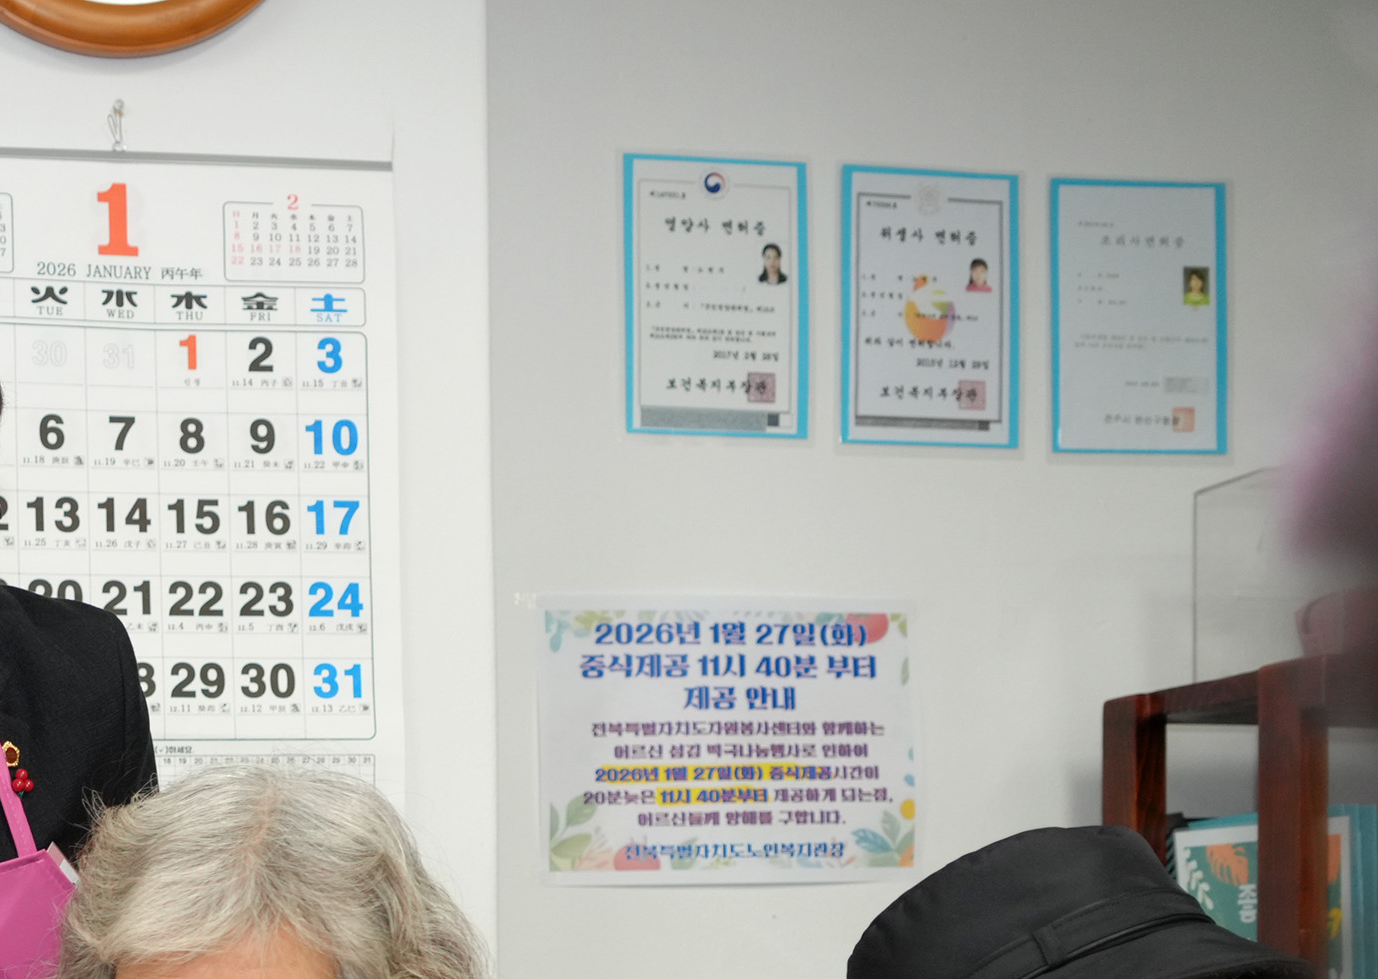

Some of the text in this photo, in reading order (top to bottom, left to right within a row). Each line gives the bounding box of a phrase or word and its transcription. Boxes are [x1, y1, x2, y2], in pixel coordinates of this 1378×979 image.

[287, 194, 299, 210] 2
[97, 182, 139, 257] 1
[37, 262, 76, 277] 2026
[86, 265, 151, 280] JANUARY
[31, 286, 68, 305] 火
[101, 288, 138, 307] 水
[170, 291, 208, 310] 木
[241, 291, 279, 311] 金
[311, 293, 348, 312] 土
[36, 306, 63, 316] TUE
[106, 308, 134, 320] WED
[176, 310, 204, 321] THU
[250, 312, 271, 322] FRI
[317, 312, 342, 322] SAT
[179, 334, 197, 370] 1
[248, 336, 274, 372] 2
[317, 337, 342, 373] 3
[39, 413, 359, 456] 6 7 8 9 10
[26, 496, 360, 535] 13 14 15 16 17
[101, 580, 152, 615] 21
[168, 581, 224, 616] 22
[239, 581, 294, 617] 23
[308, 582, 364, 617] 24
[595, 622, 867, 647] 2026년 1월 27일(화)
[580, 654, 876, 678] 중식제공 11시 40분 부터
[170, 662, 225, 699] 29
[241, 662, 296, 699] 30
[313, 663, 362, 698] 31
[684, 686, 796, 711] 제공 안내
[822, 721, 885, 737] 함께하는
[614, 744, 662, 760] 어르신
[822, 743, 869, 759] 인하여
[595, 767, 658, 783] 2026년
[664, 766, 687, 781] 1월
[693, 765, 763, 781] 27일(화)
[660, 789, 691, 804] 11시
[697, 788, 768, 803] 40분부터
[773, 788, 836, 803] 제공하게
